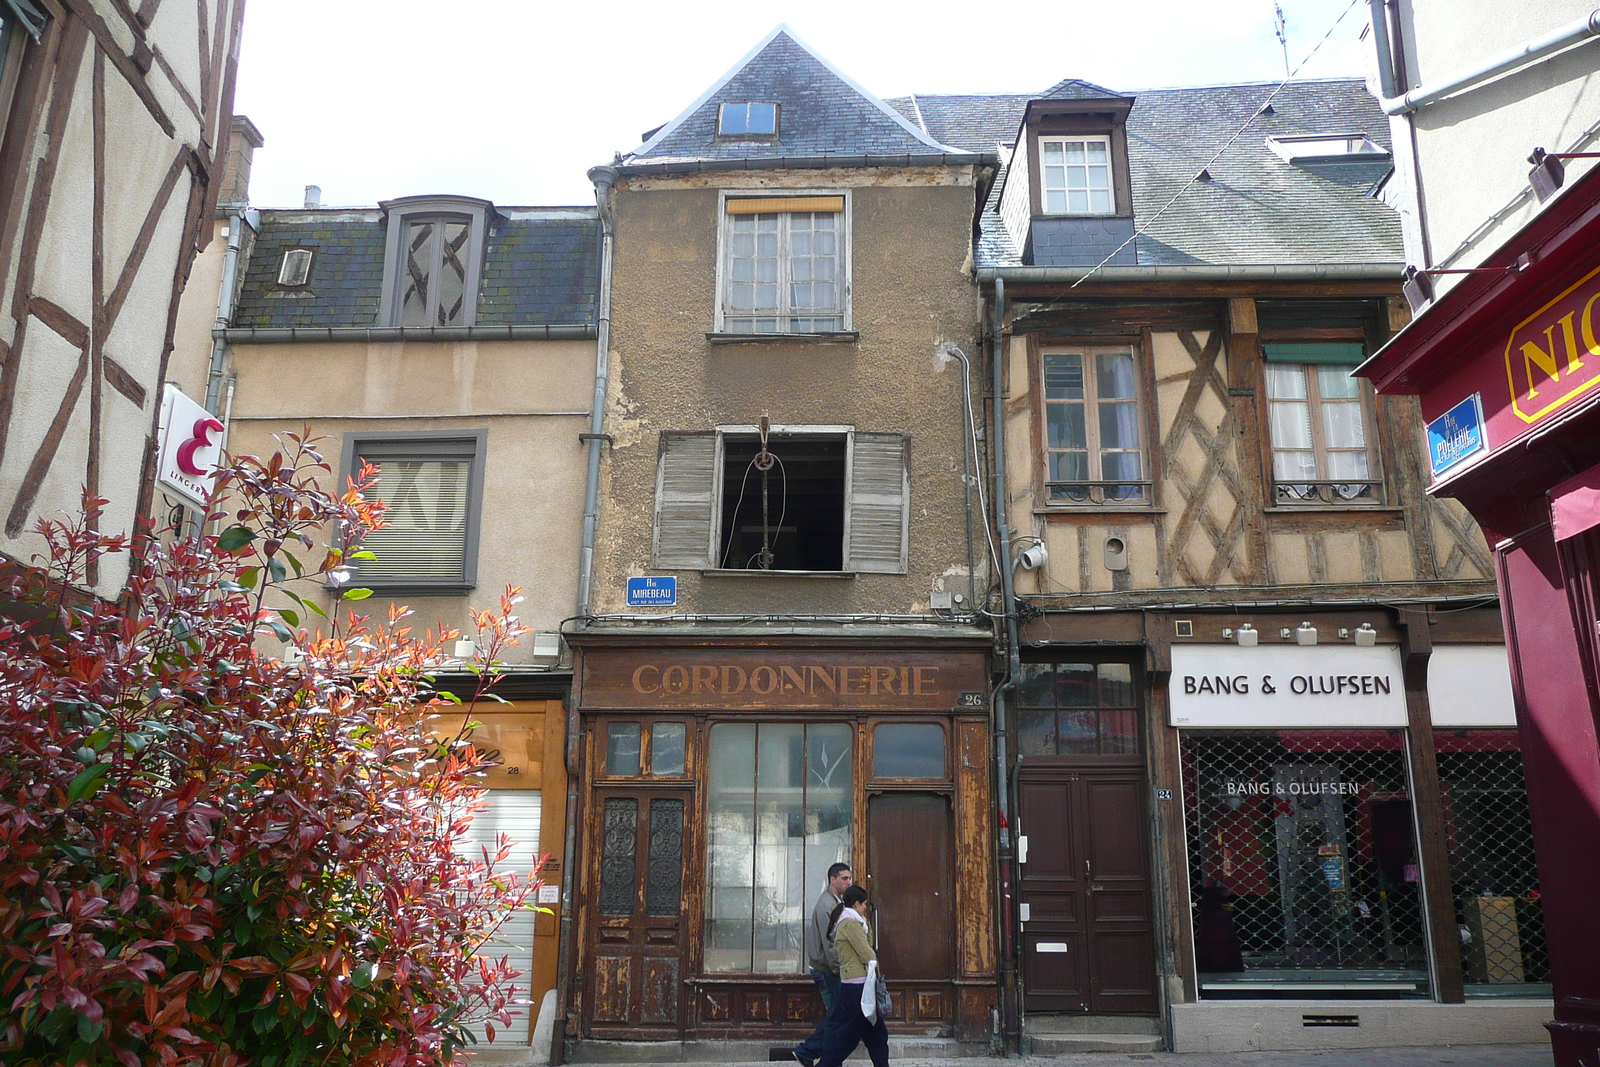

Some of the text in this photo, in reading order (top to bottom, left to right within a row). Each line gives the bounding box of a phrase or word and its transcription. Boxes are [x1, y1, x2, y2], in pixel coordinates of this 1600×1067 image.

[632, 589, 671, 599] MIREBEAU
[631, 664, 940, 696] CORDONNERIE
[1183, 675, 1391, 695] BANG & OLUFSEN
[965, 694, 982, 706] 26
[1159, 790, 1171, 799] 24
[1227, 782, 1359, 795] BANG & OLUFSEN
